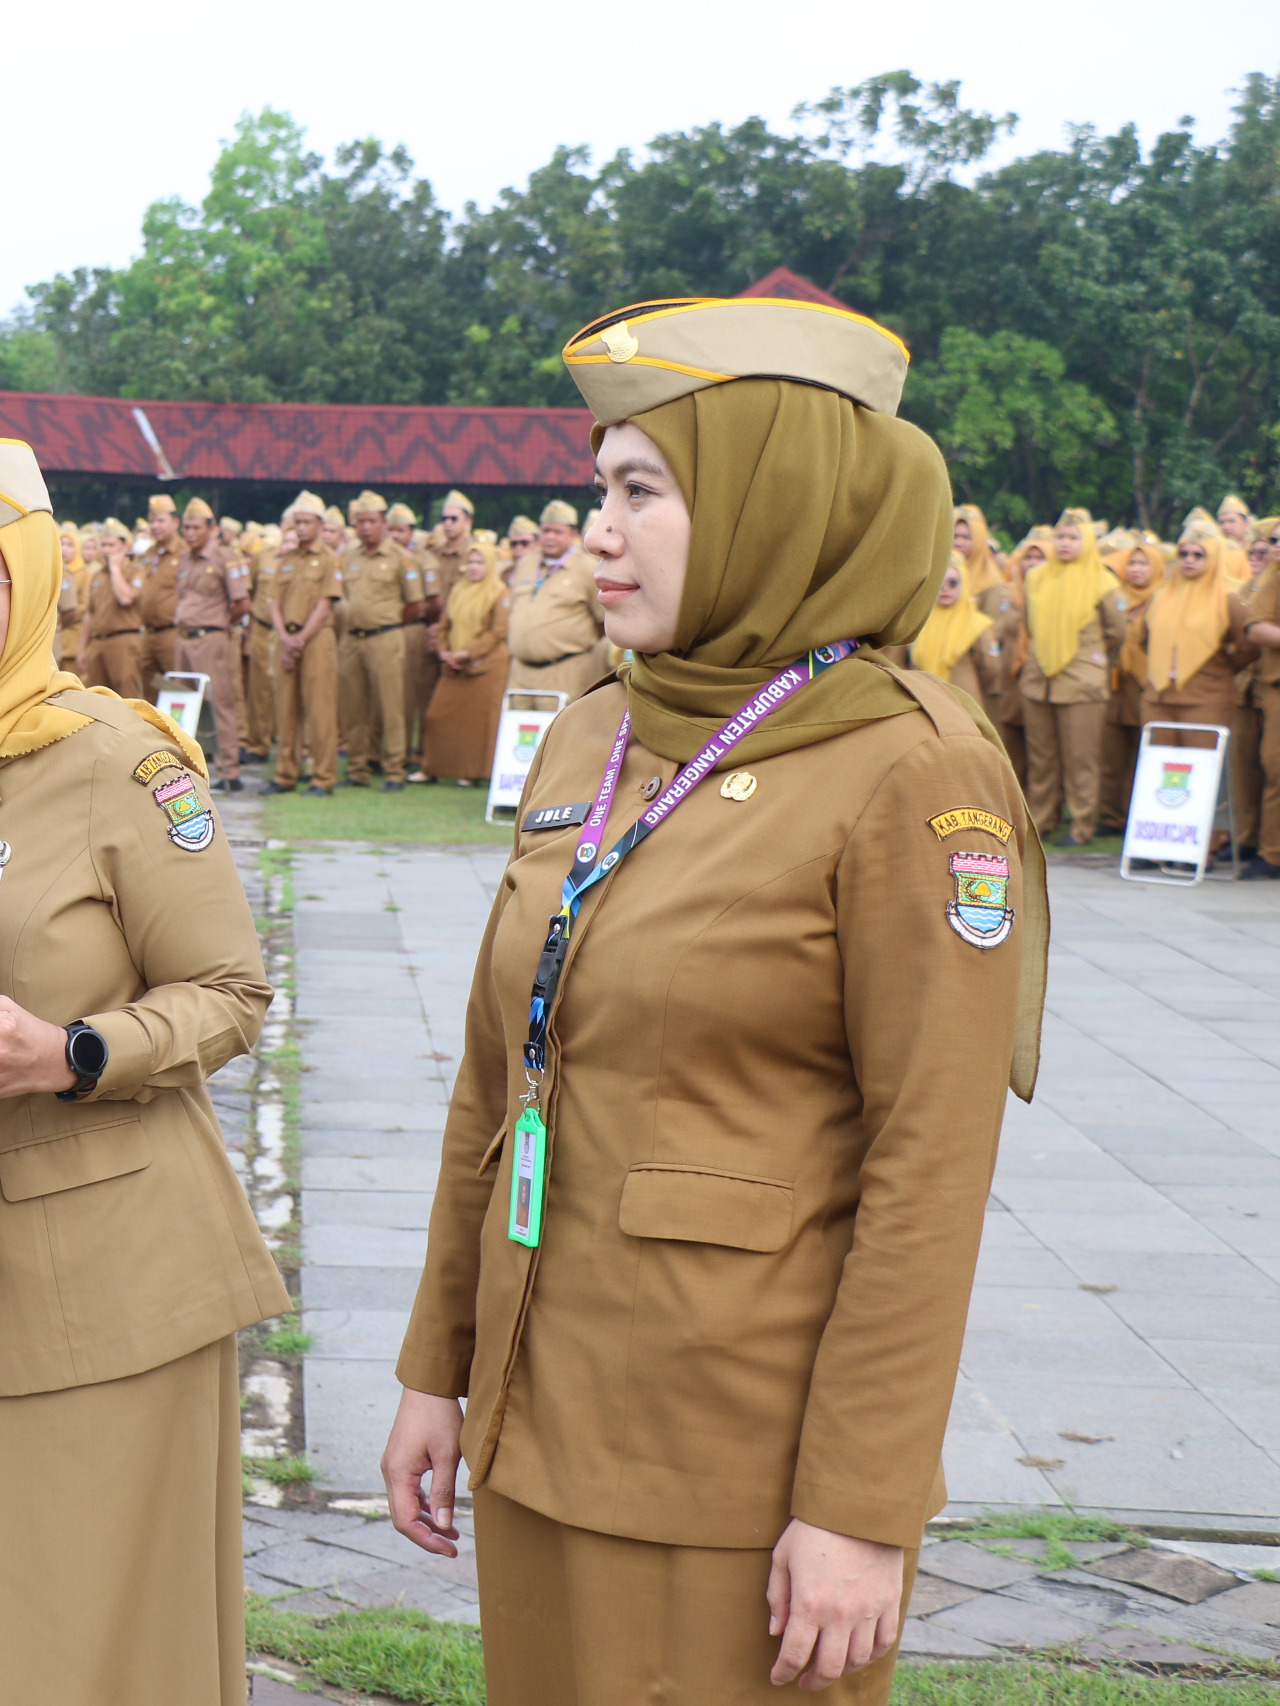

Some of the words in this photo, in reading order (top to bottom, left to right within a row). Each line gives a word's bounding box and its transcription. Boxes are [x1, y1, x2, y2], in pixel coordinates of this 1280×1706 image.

[718, 669, 803, 746] KABUPATEN
[534, 807, 573, 824] JULE
[590, 804, 607, 827] ONE
[599, 764, 619, 802] TEAM,
[611, 738, 625, 763] ONE
[644, 743, 724, 825] TANGERANG
[960, 811, 1009, 838] TANGERANG
